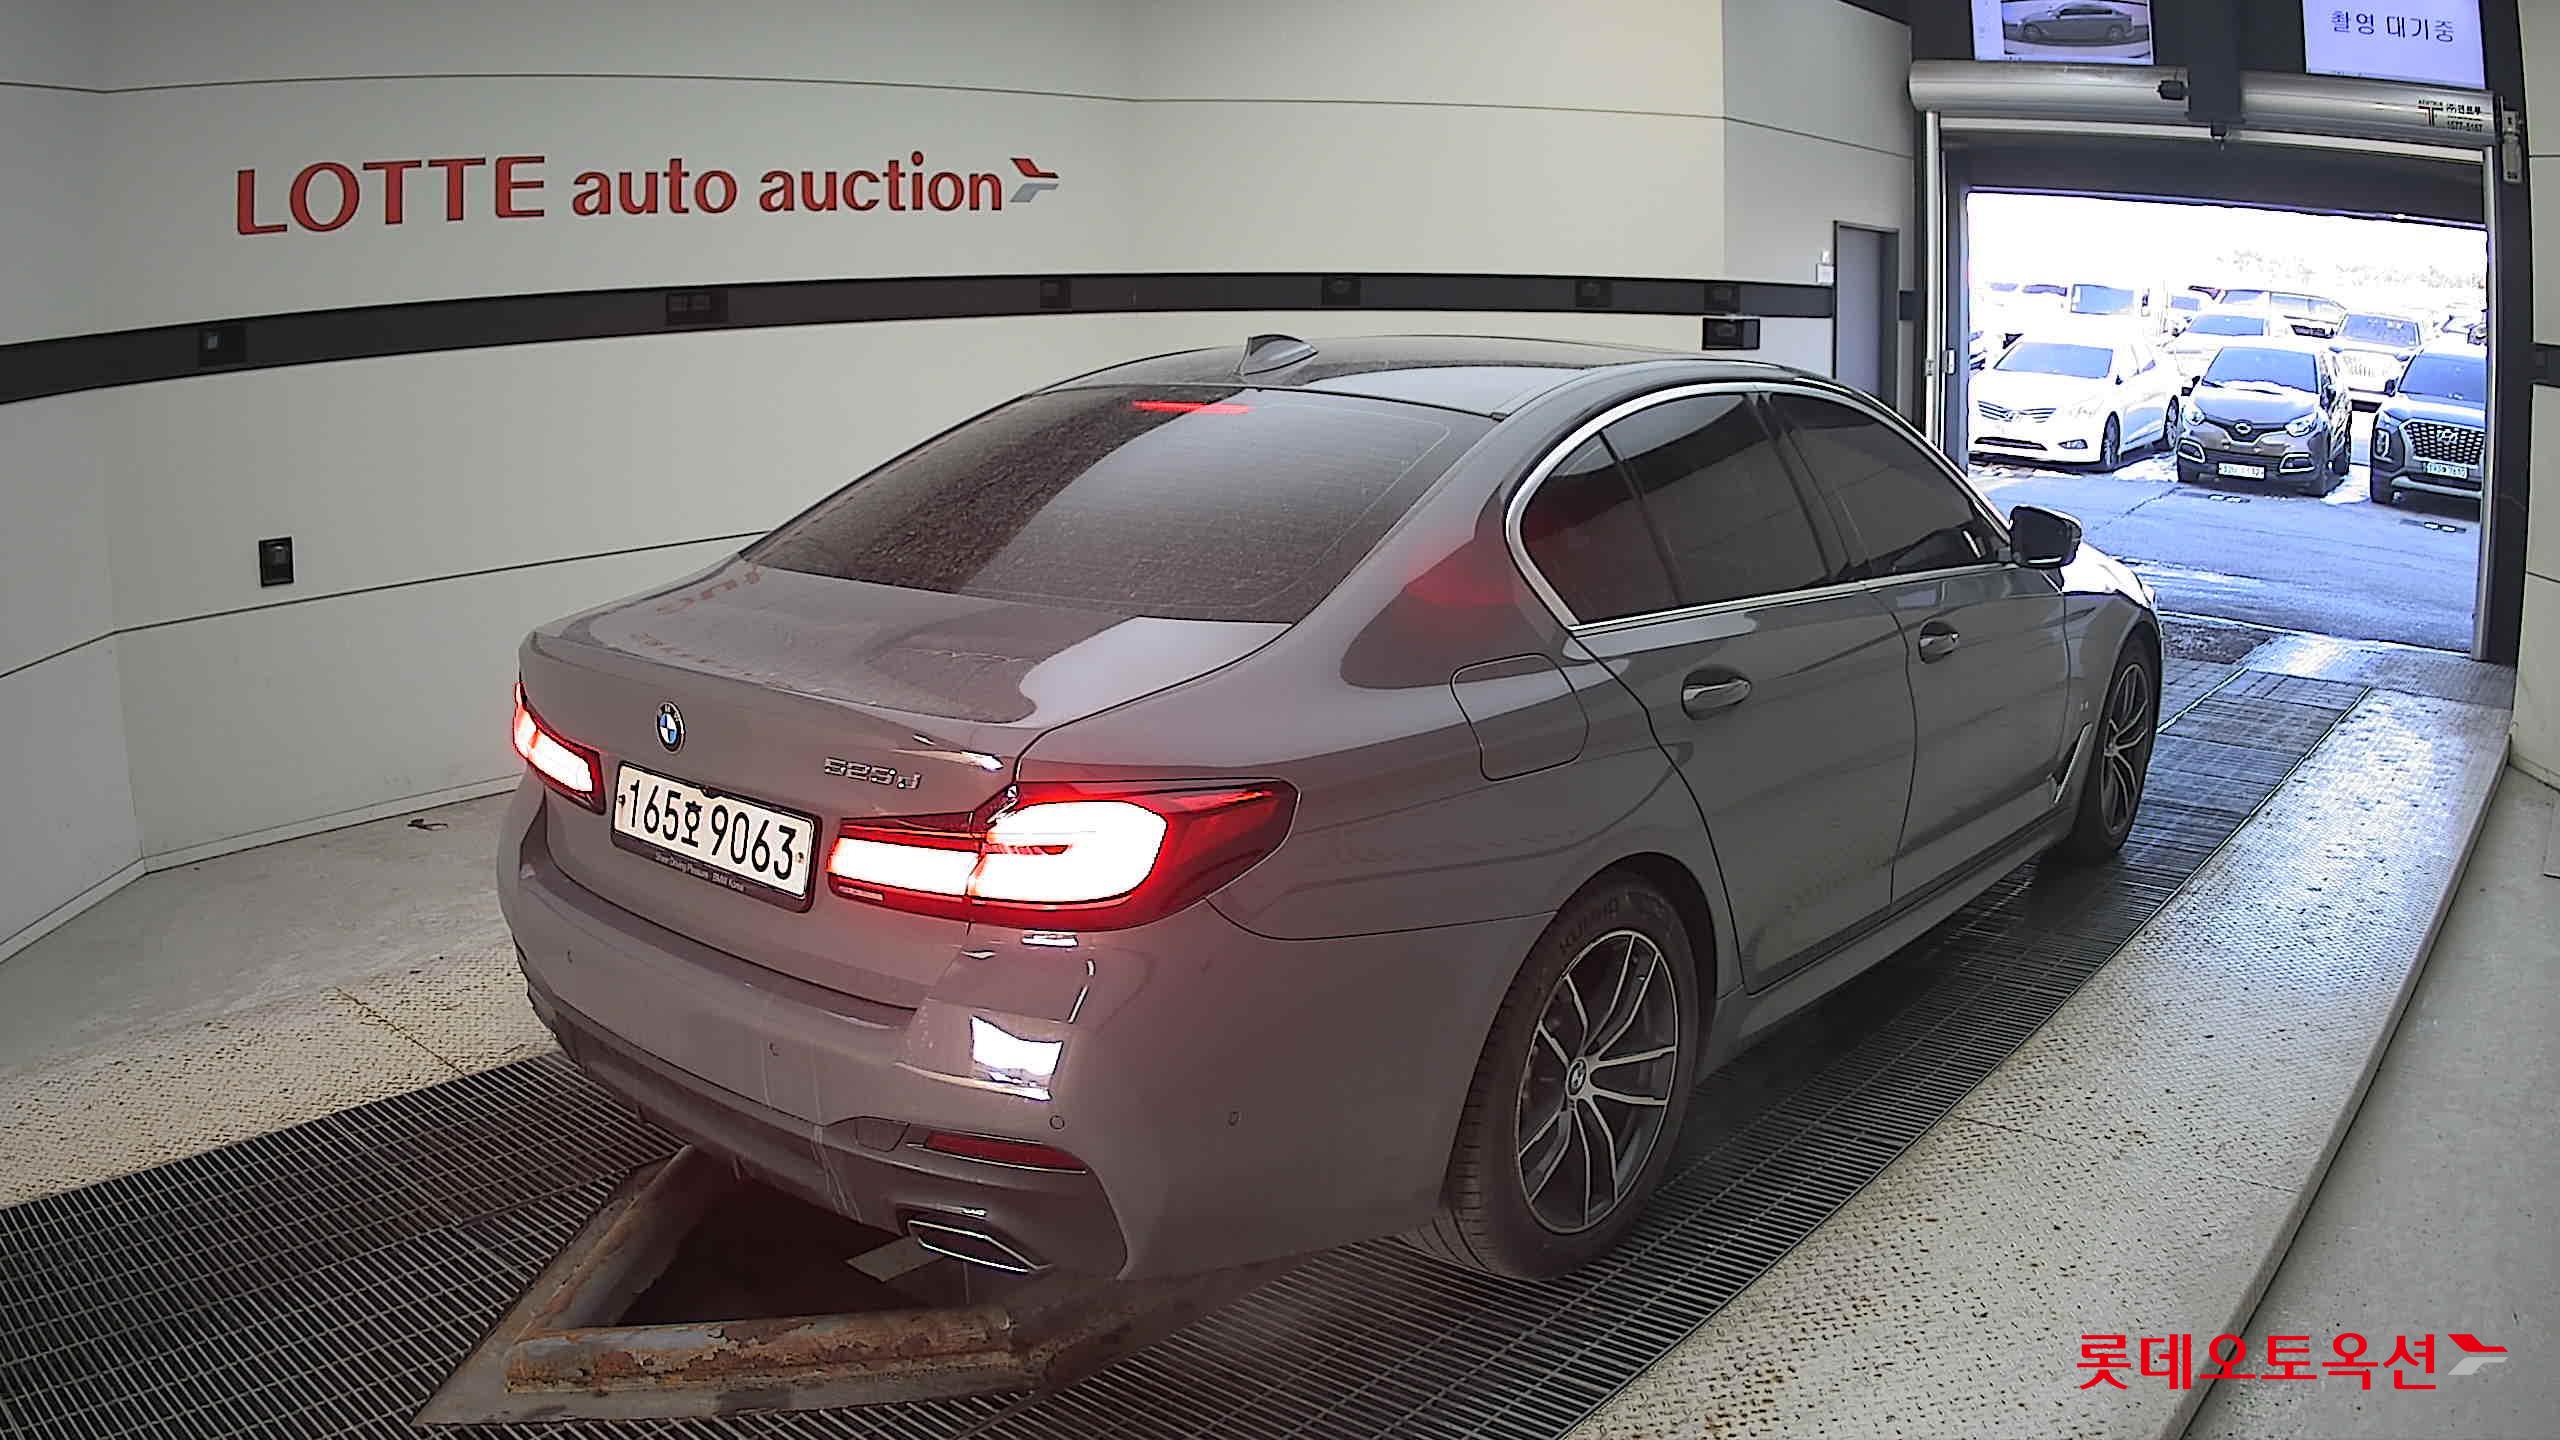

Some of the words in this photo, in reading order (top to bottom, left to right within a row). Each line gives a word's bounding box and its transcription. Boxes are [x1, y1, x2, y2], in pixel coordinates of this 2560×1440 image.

[2331, 10, 2375, 36] 촬영
[2386, 15, 2454, 43] 대기중
[236, 155, 545, 235] LOTTE
[571, 158, 738, 216] auto
[760, 151, 1003, 213] auction
